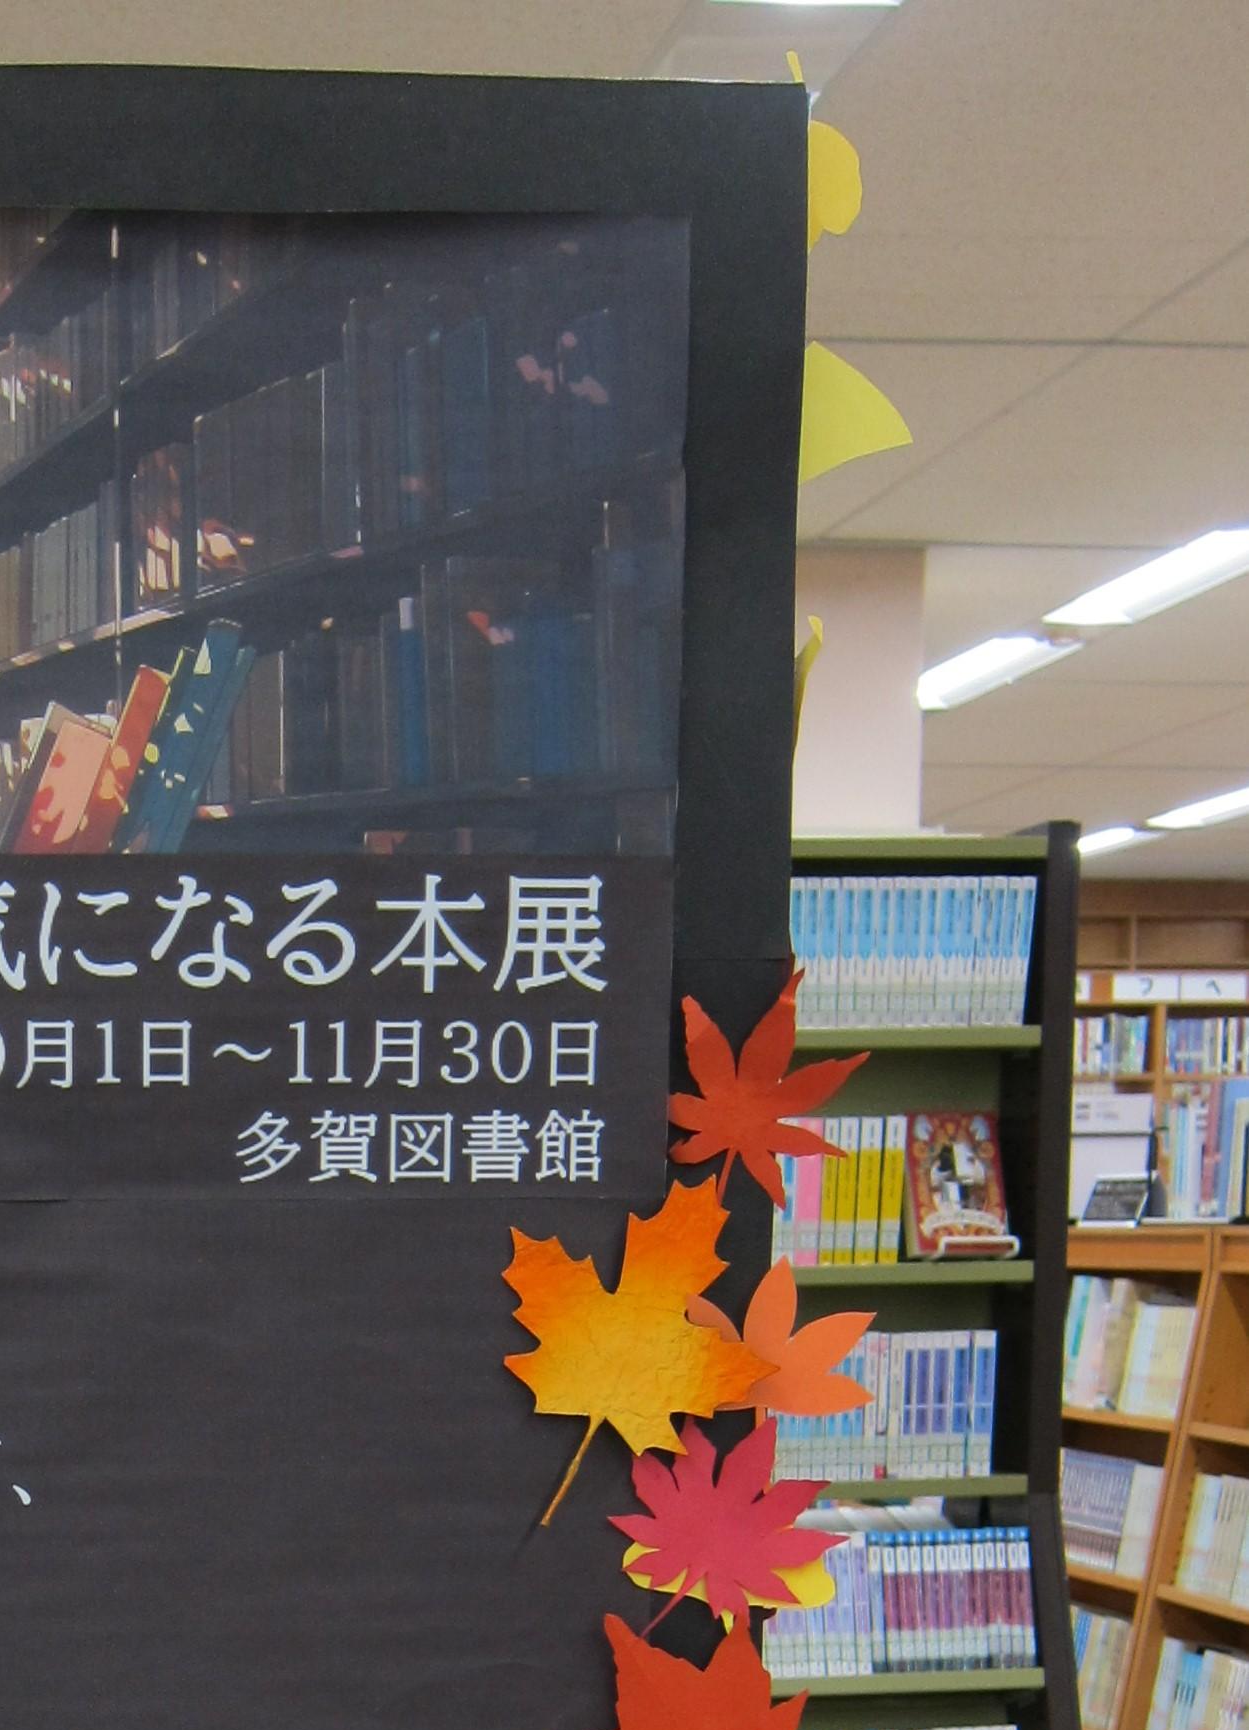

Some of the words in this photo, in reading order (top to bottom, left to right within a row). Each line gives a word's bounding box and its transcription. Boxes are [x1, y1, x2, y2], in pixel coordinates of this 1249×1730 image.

[236, 1110, 604, 1182] 多賀図書館
